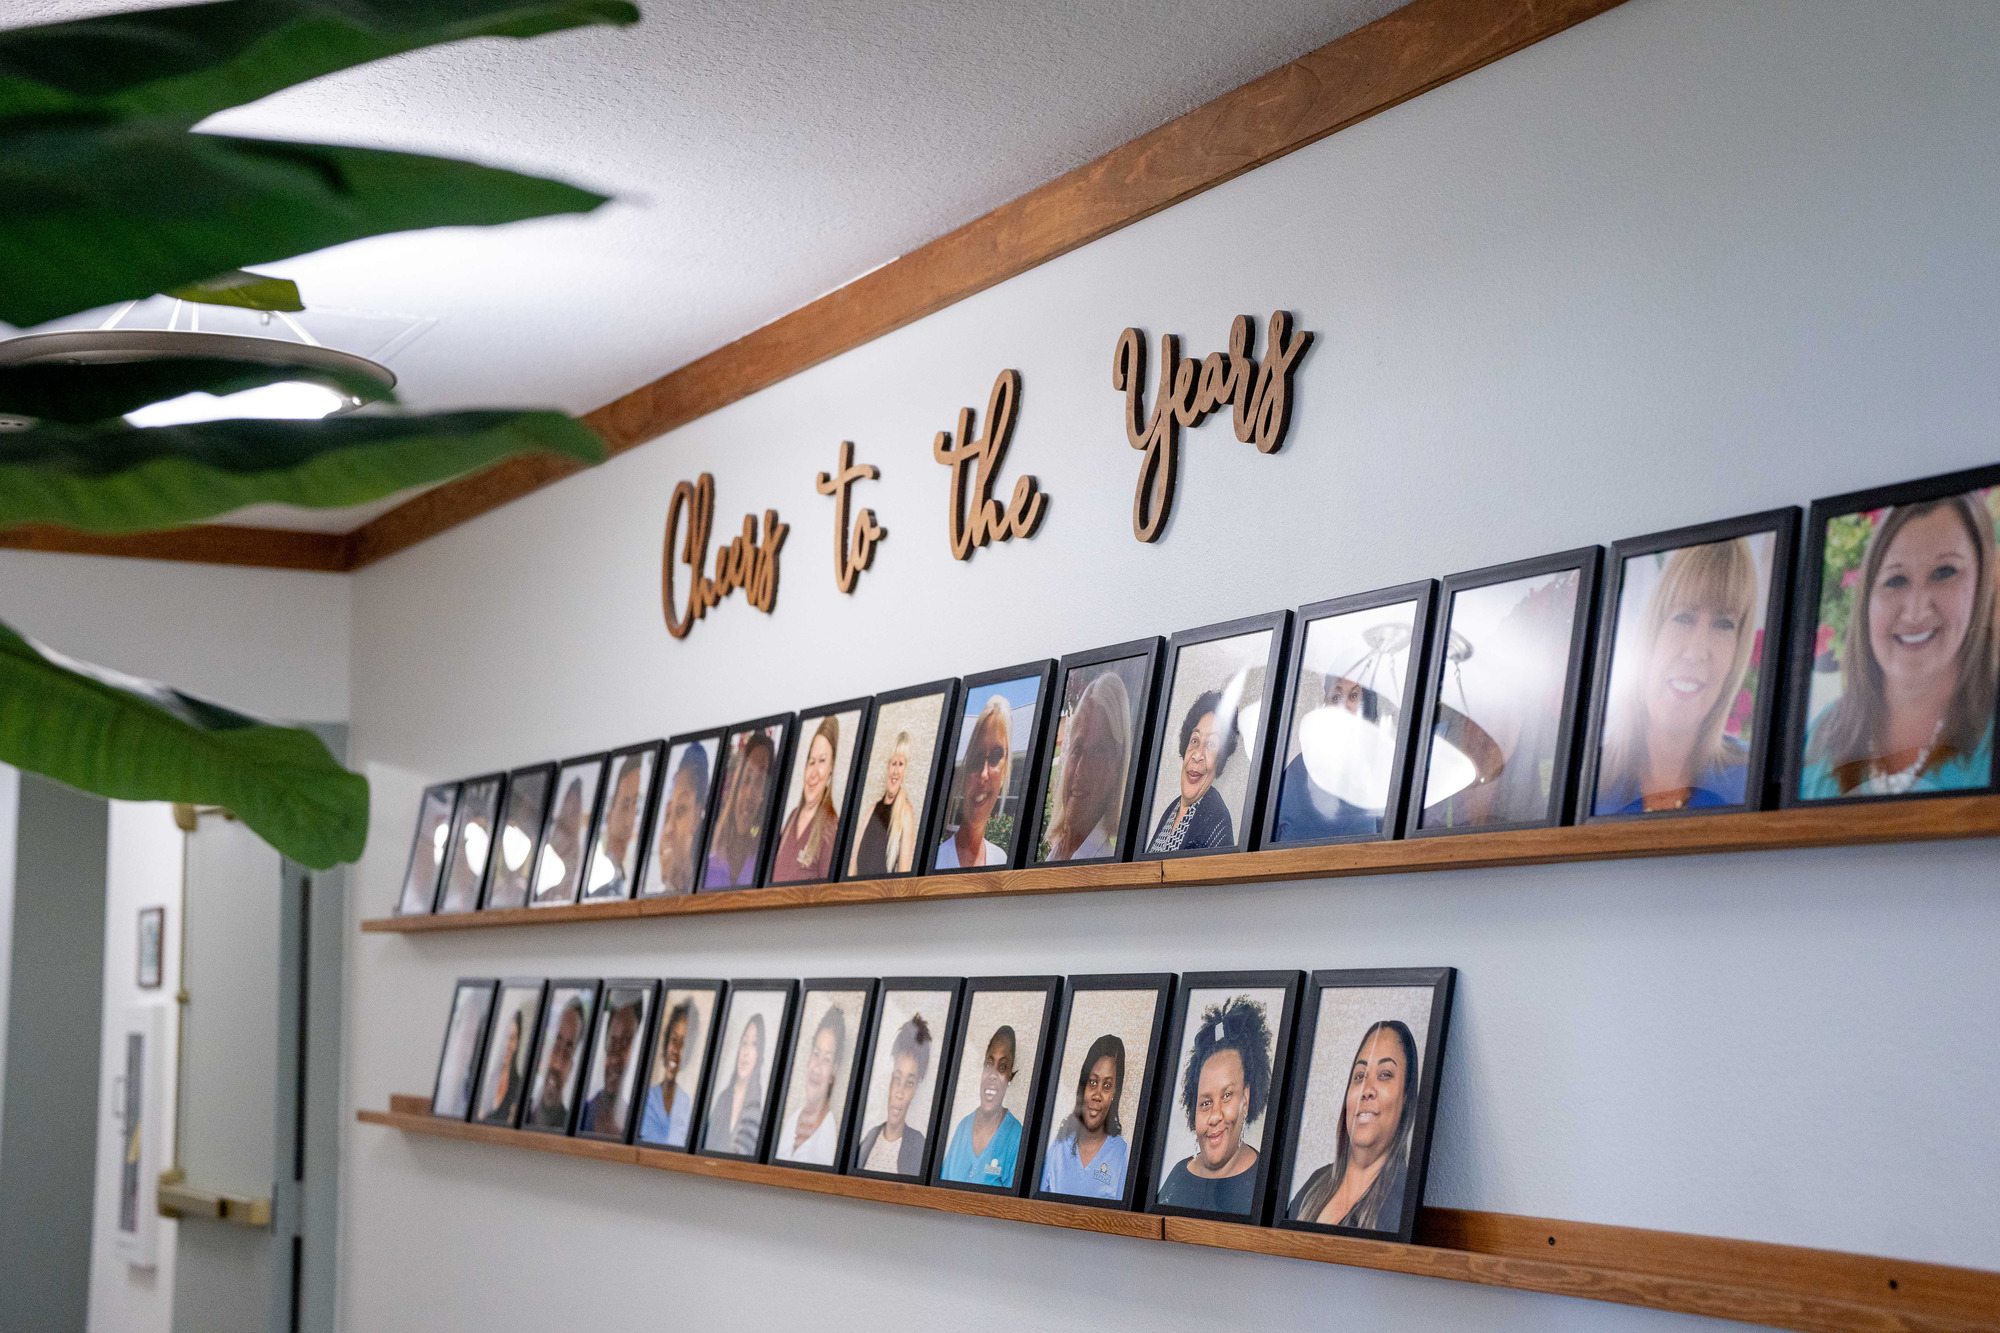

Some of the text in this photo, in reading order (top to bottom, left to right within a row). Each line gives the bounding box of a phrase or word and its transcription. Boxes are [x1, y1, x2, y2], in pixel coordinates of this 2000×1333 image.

[662, 310, 1314, 638] Cheers to the Years
